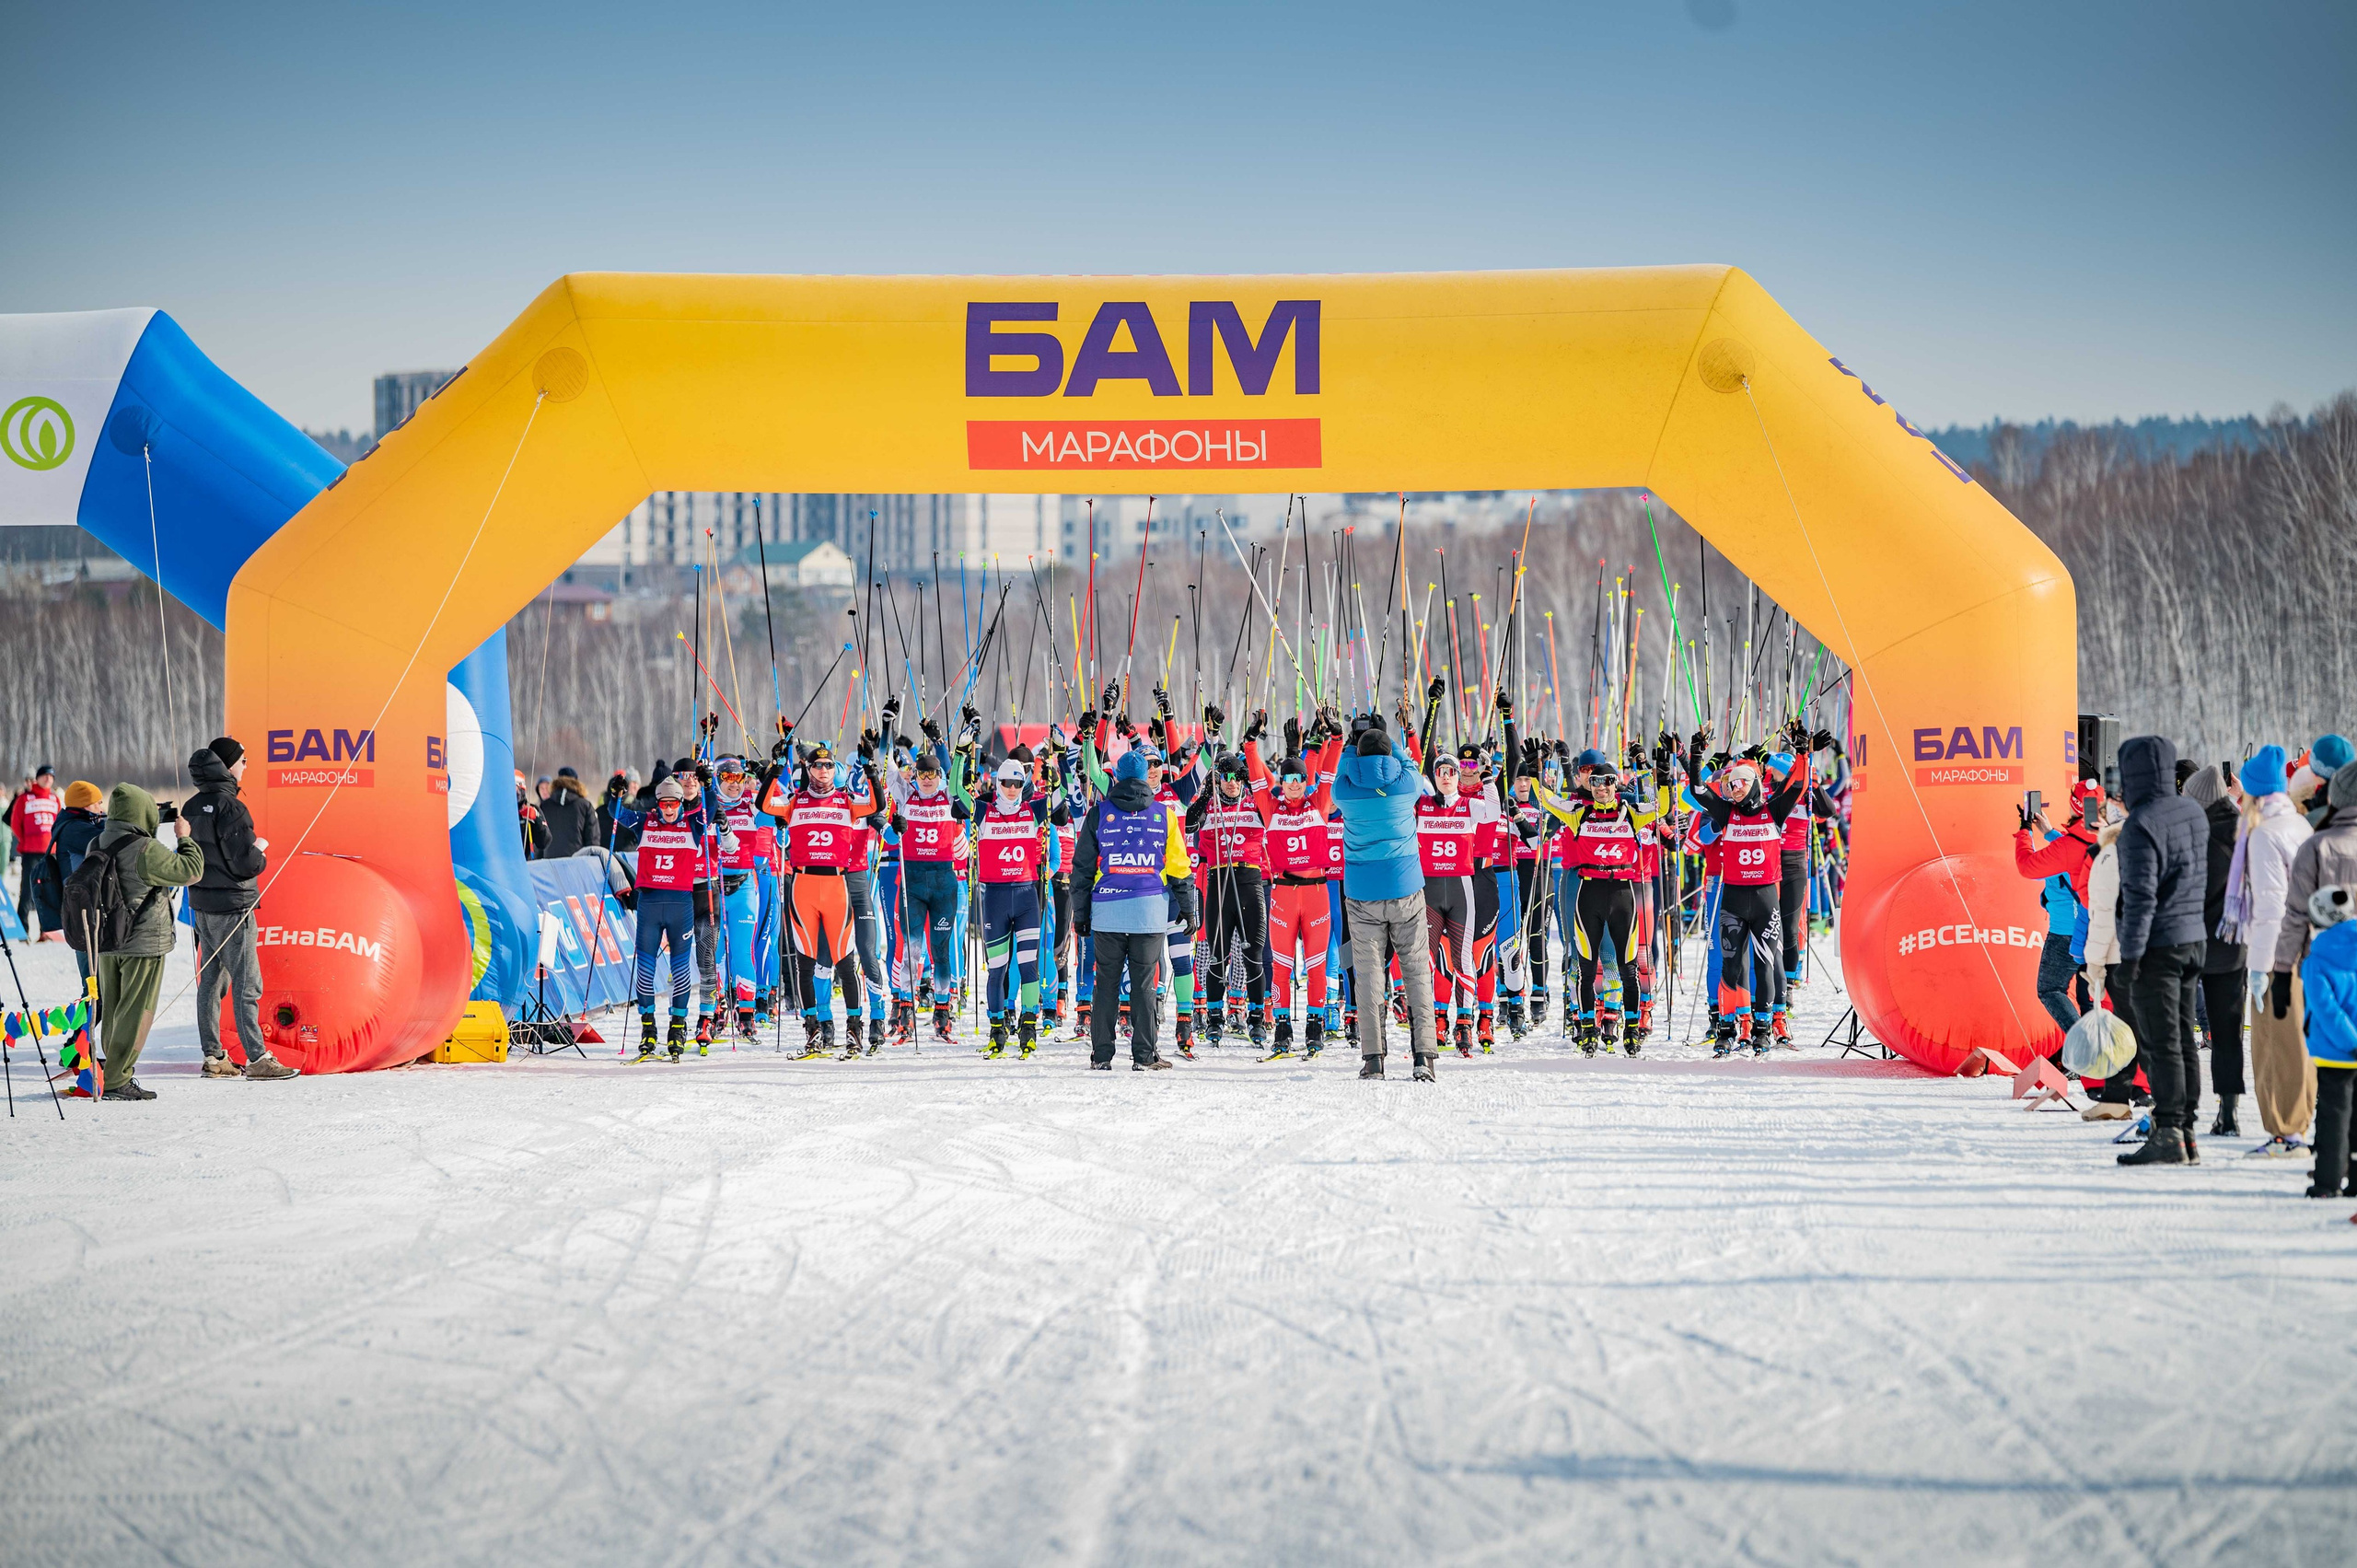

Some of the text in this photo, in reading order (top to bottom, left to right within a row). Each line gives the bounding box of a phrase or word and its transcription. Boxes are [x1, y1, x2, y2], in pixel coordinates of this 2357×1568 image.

[966, 300, 1320, 397] БАМ
[1022, 429, 1267, 462] МАРАФОНЫ
[268, 729, 375, 762] БАМ
[1914, 726, 2023, 761] БАМ
[281, 772, 358, 784] МАРАФОНЫ
[1931, 769, 2009, 783] МАРАФОНЫ
[798, 811, 843, 820] ТЕМЕРСО
[1423, 820, 1465, 829] ТЕМЕРСО
[807, 830, 833, 847] 29
[915, 828, 938, 843] 38
[1220, 833, 1246, 846] 90
[1286, 835, 1307, 852] 91
[998, 845, 1025, 862] 40
[1431, 841, 1457, 857] 58
[1594, 843, 1622, 859] 44
[1738, 849, 1765, 865] 89
[655, 855, 674, 870] 13
[1109, 853, 1155, 865] БАМ
[1760, 907, 1780, 940] BLACK
